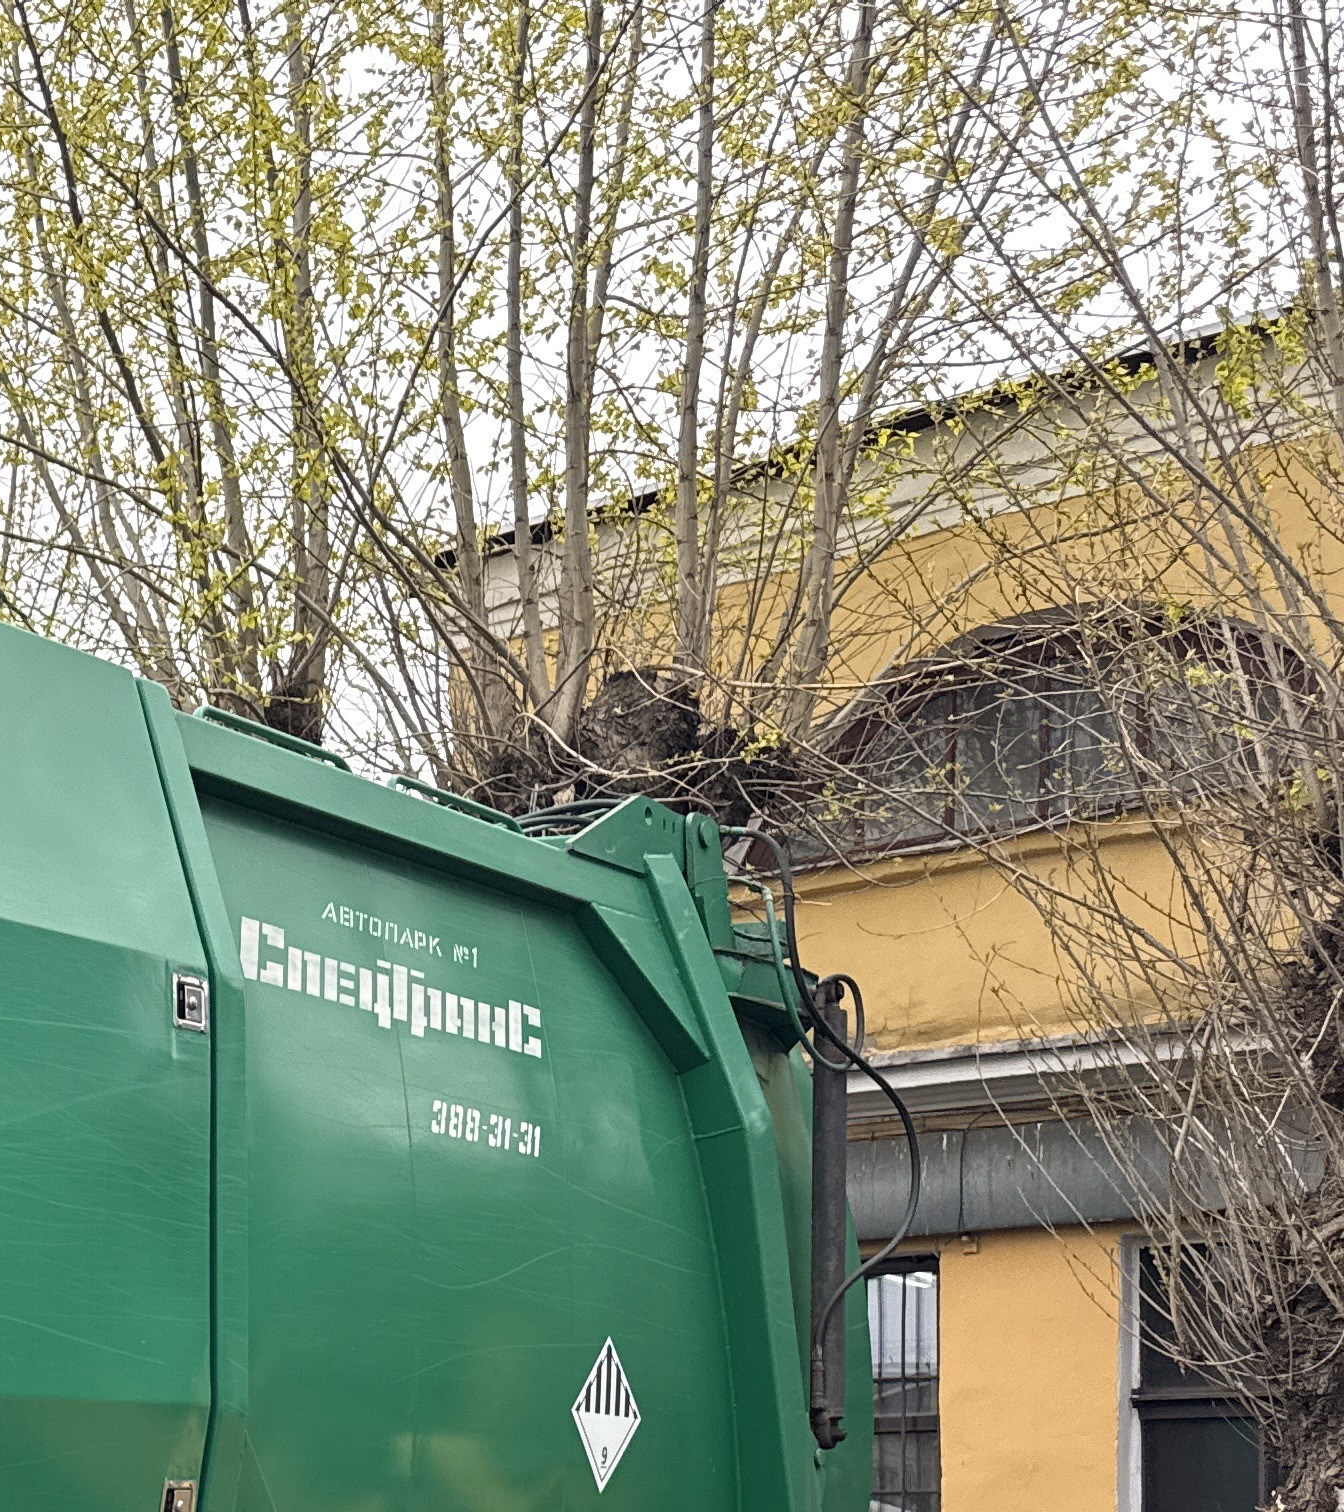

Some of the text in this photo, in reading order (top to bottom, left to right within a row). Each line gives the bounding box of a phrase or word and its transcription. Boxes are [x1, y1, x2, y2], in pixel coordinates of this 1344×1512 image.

[322, 901, 479, 968] АВТОПАРК №1
[431, 1100, 542, 1158] 388-31-31
